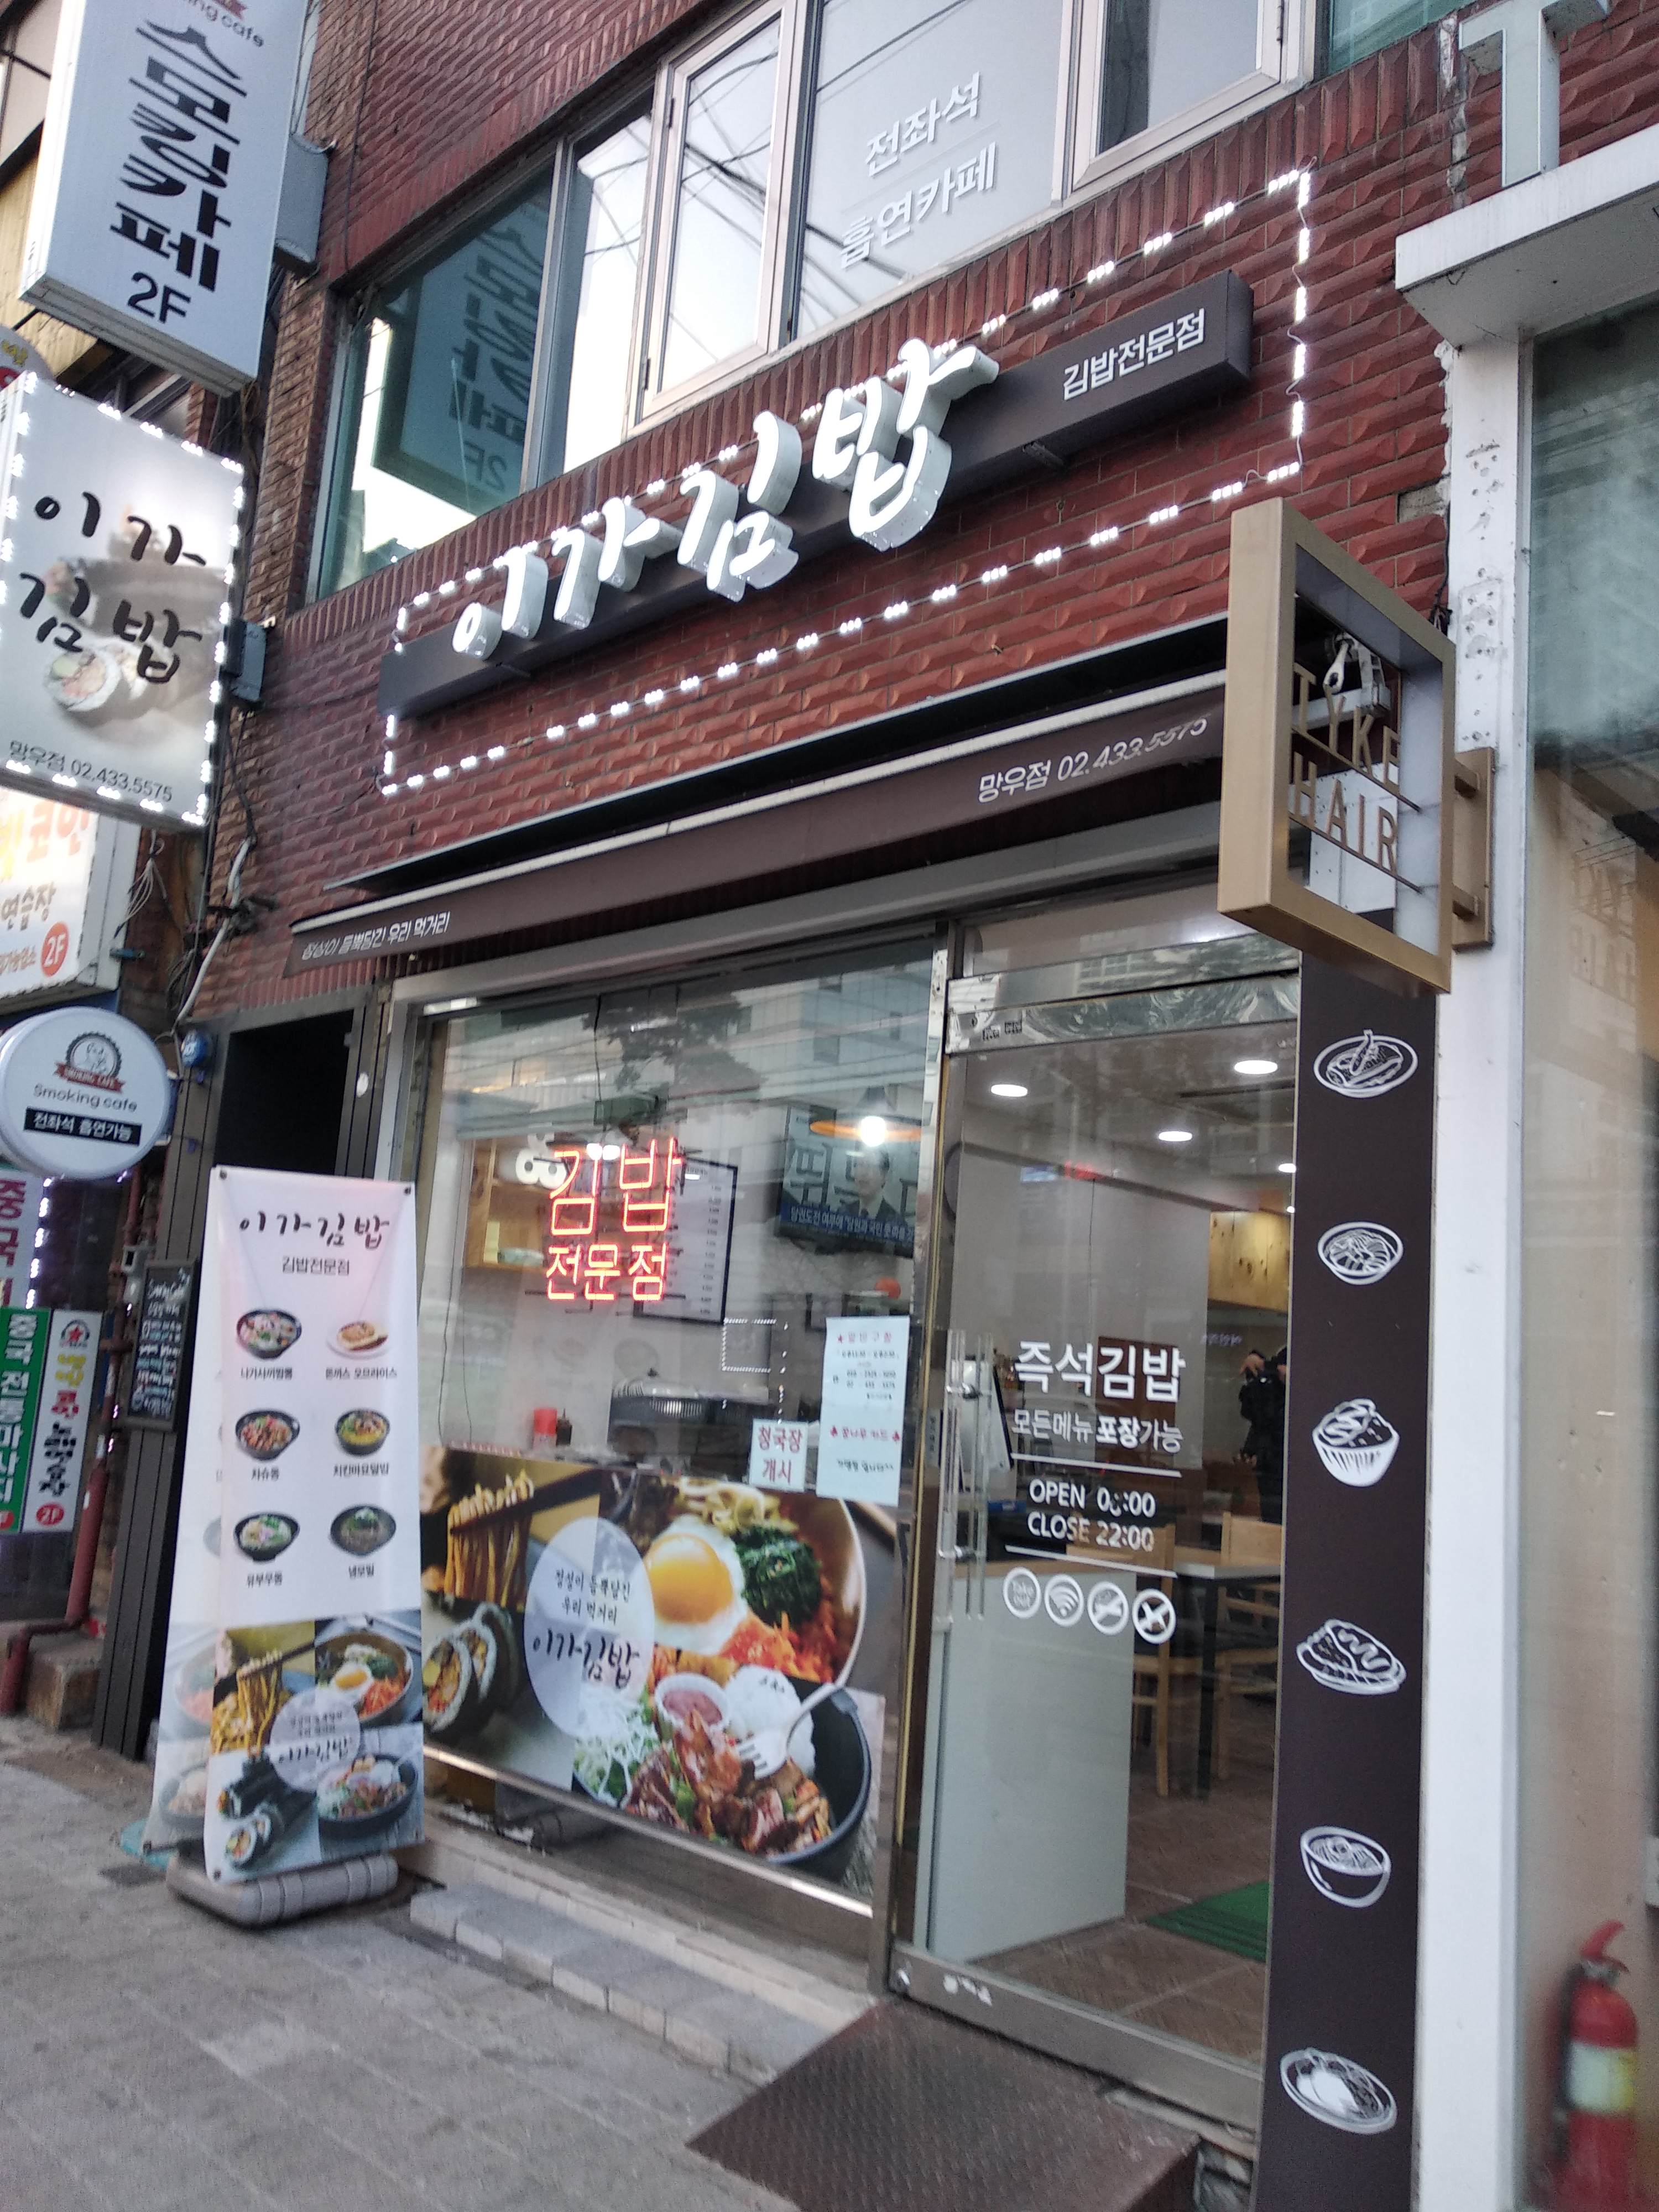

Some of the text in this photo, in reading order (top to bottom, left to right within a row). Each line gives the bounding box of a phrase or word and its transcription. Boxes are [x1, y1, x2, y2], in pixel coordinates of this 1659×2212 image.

[221, 15, 264, 48] cafe
[865, 71, 981, 178] 전좌석
[109, 18, 247, 293] 스모킹카페
[841, 142, 996, 269] 흡연카페
[127, 272, 191, 324] 2F
[1063, 308, 1206, 400] 김밥전문점
[452, 337, 999, 659] 이가김밥
[35, 492, 206, 566] 이가
[20, 573, 202, 684] 김밥
[1292, 662, 1400, 796] TYKE
[71, 759, 173, 802] 02.433.5575
[978, 760, 1051, 803] 망우점
[1294, 752, 1398, 875] HAIR
[44, 932, 66, 967] 2F
[388, 920, 412, 945] 우리
[413, 911, 451, 938] 먹거리
[33, 1083, 138, 1113] Smoking cafe
[550, 1136, 683, 1237] 김밥
[239, 1211, 390, 1249] 이가김밥
[546, 1241, 669, 1302] 전문점
[1014, 1340, 1186, 1403] 즉석김밥
[758, 1425, 803, 1454] 청국장
[1011, 1409, 1183, 1453] 모든메뉴 포장가능
[762, 1458, 793, 1484] 개시
[1029, 1479, 1086, 1509] OPEN
[1027, 1511, 1155, 1552] CLOSE 22:00
[533, 1628, 640, 1689] 이가김밥
